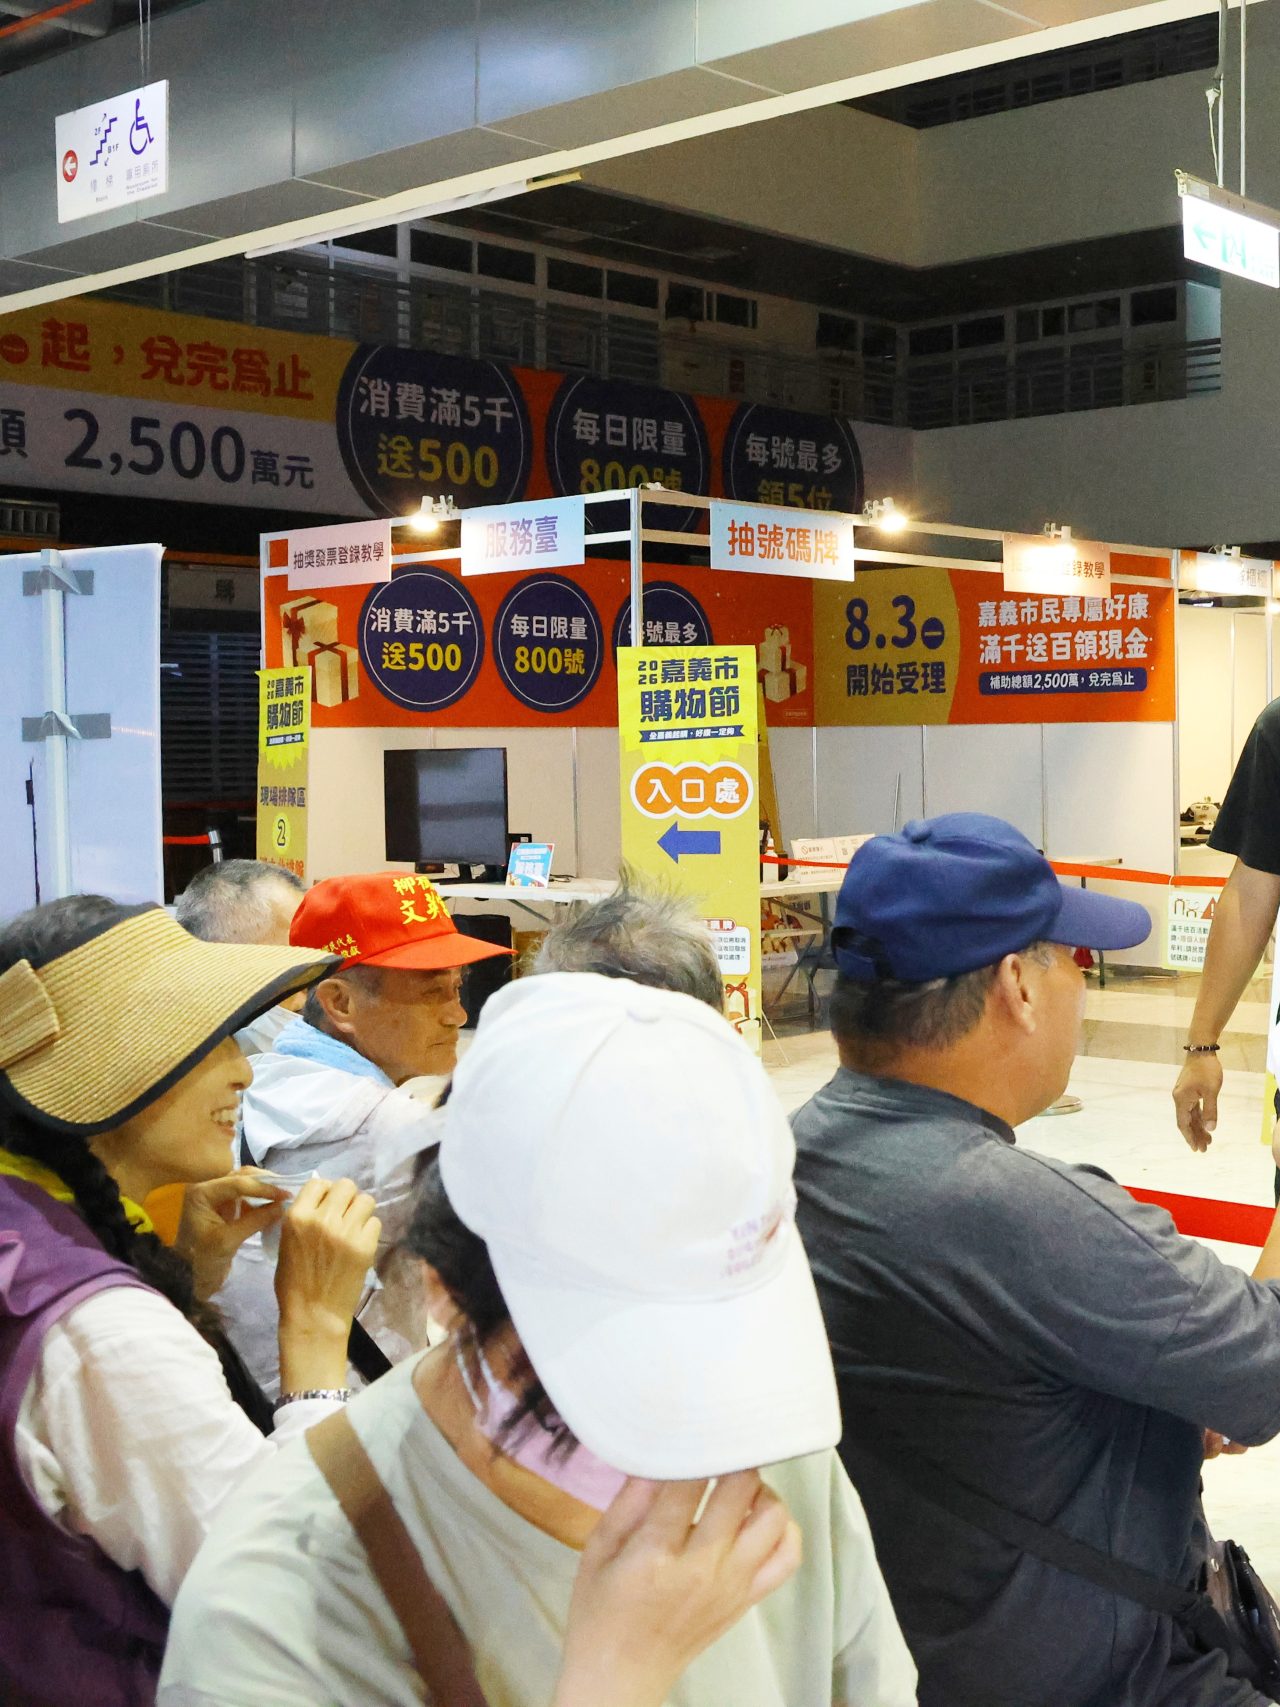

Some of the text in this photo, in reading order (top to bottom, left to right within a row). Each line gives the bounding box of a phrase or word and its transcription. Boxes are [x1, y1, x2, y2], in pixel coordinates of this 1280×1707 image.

[94, 127, 101, 136] 2F
[107, 144, 119, 153] B1F
[359, 376, 514, 433] 消費滿5千
[573, 408, 688, 456] 每日限量
[64, 408, 314, 490] 2,500萬元
[376, 433, 499, 487] 送500
[745, 432, 843, 475] 每號最多
[484, 515, 560, 559] 服務臺
[727, 519, 840, 566] 抽號碼牌
[293, 541, 385, 570] 抽獎發票登錄教學
[370, 607, 472, 635] 消費滿5千
[978, 593, 1149, 628] 嘉義市民專屬好康
[510, 614, 588, 641] 每日限量
[628, 620, 698, 644] 號最多
[381, 642, 462, 672] 送500
[979, 627, 1148, 665] 滿千送百領現金
[514, 647, 586, 676] 800號
[638, 661, 658, 671] 20
[661, 656, 739, 683] 嘉義市
[638, 674, 658, 684] 26
[847, 662, 946, 697] 開始受理
[266, 700, 304, 730] 購物節
[640, 686, 740, 722] 購物節
[646, 777, 741, 804] 入口處
[276, 819, 286, 846] 2
